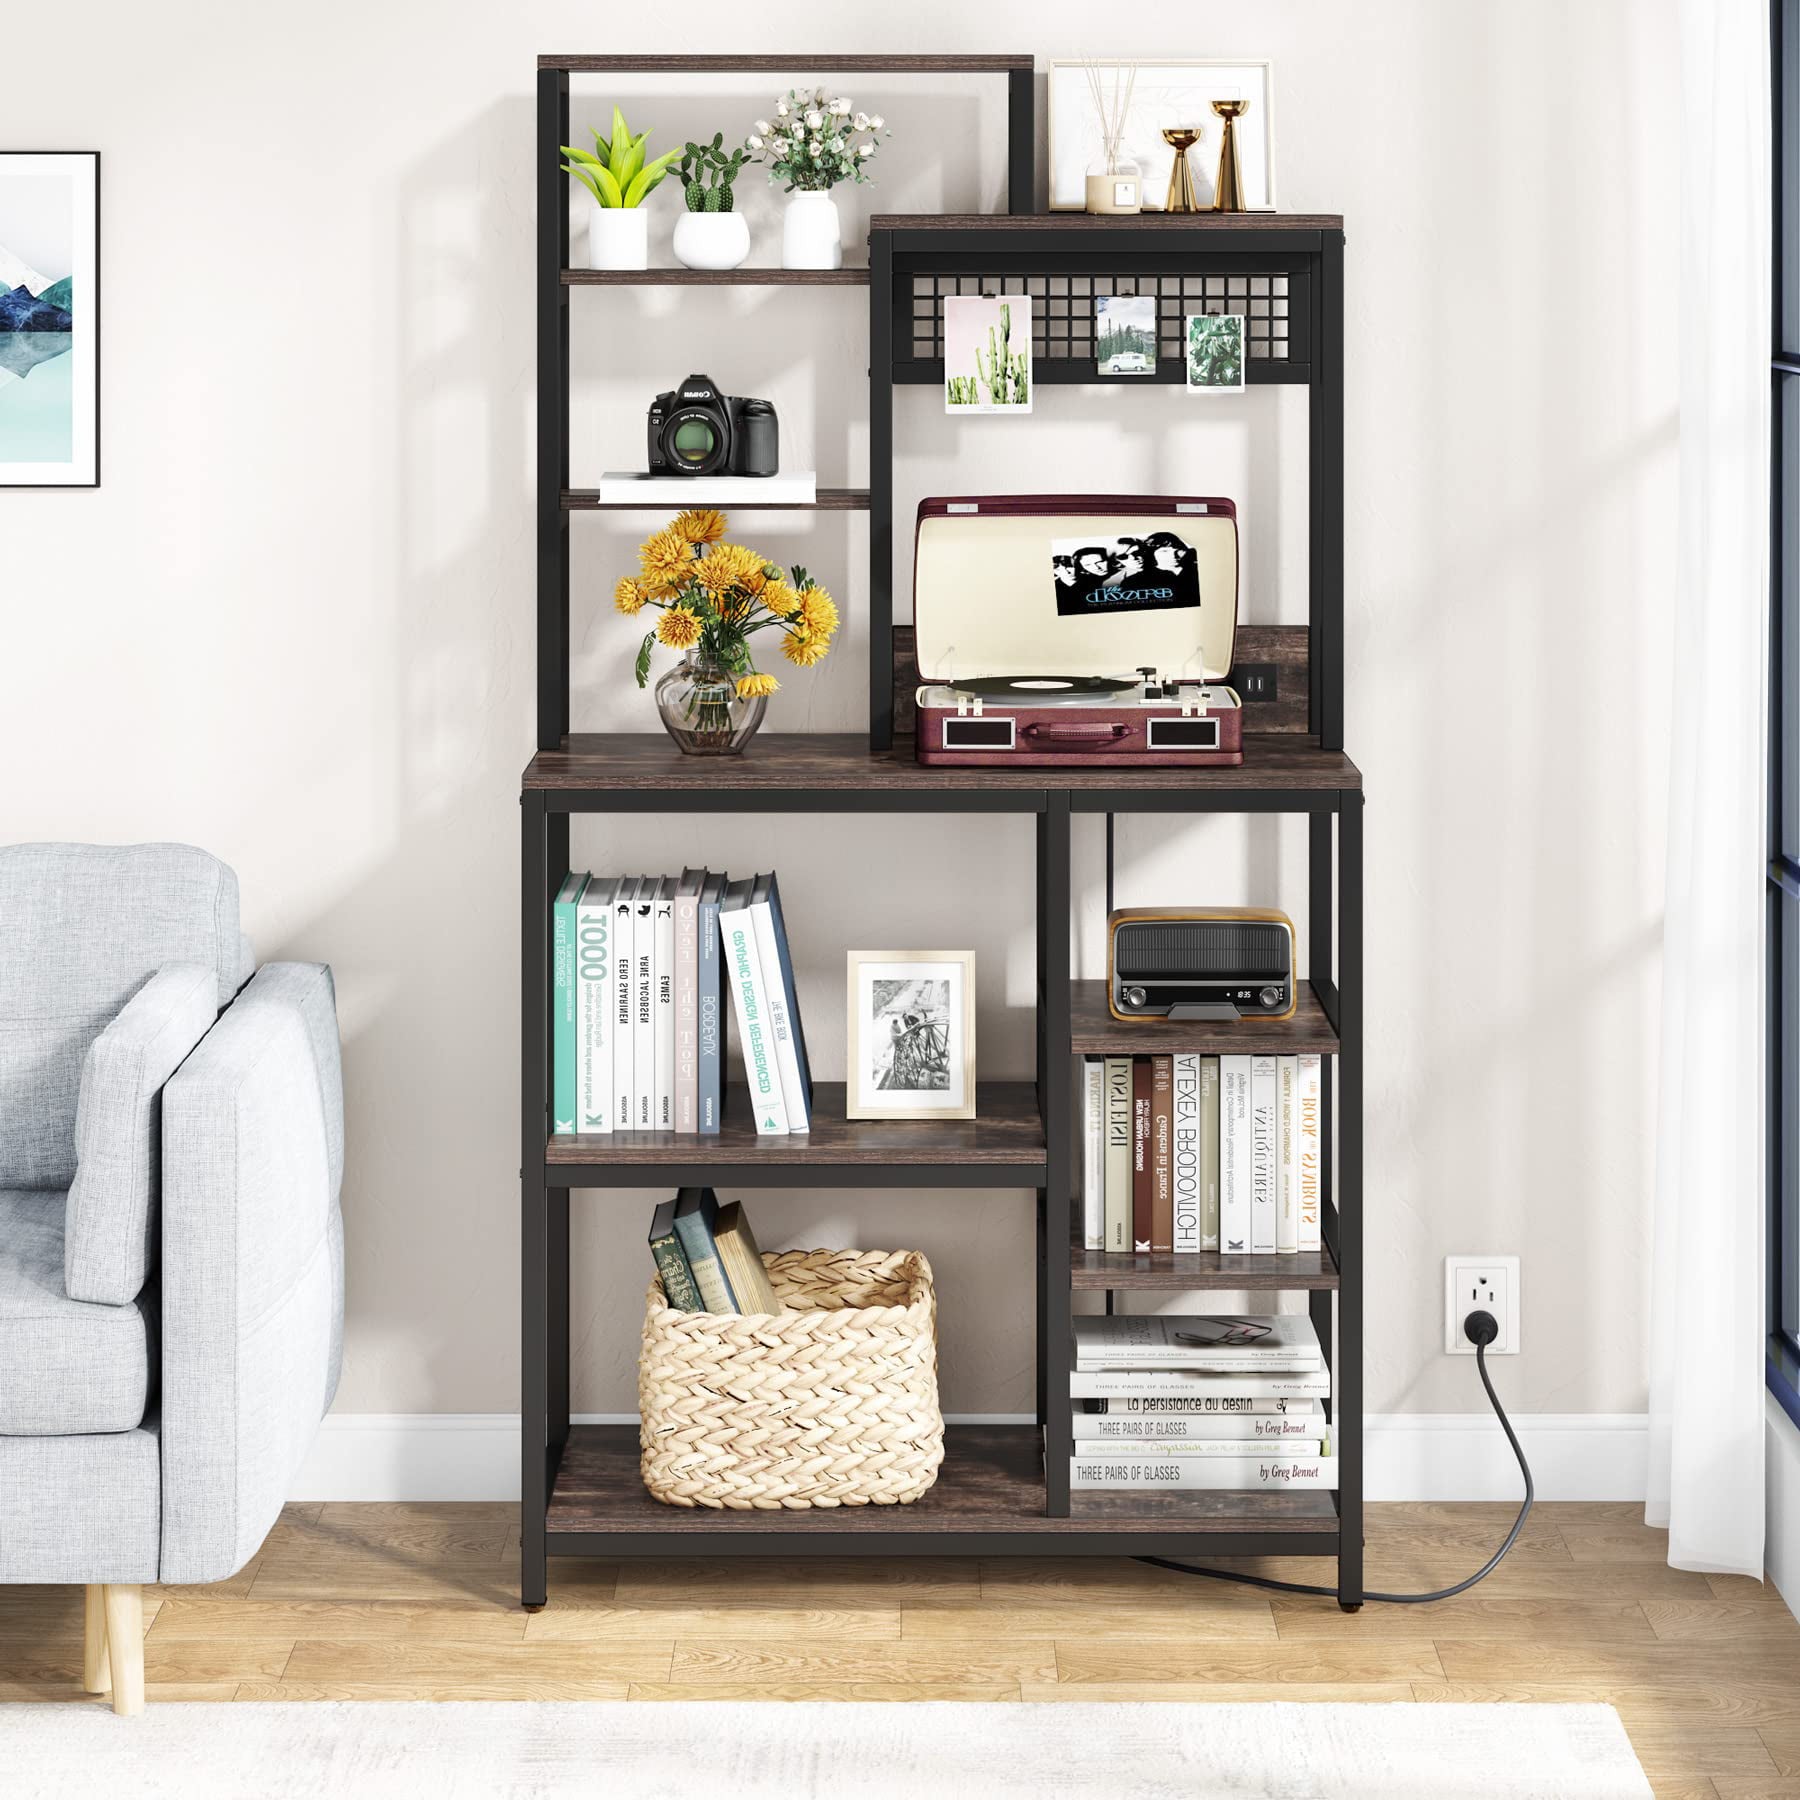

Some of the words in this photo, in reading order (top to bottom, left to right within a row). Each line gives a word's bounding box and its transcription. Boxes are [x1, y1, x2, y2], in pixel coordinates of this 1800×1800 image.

[1127, 1398, 1139, 1410] La
[1142, 1398, 1201, 1414] persistance
[1099, 1422, 1120, 1435] THREE
[1123, 1422, 1142, 1435] PAIRS
[1145, 1422, 1154, 1435] OF
[1156, 1422, 1187, 1435] GLASSES
[1256, 1421, 1264, 1435] by
[1265, 1421, 1280, 1435] Greg
[1283, 1421, 1306, 1433] Bennet
[1077, 1466, 1102, 1480] THREE
[1105, 1466, 1128, 1480] PAIRS
[1131, 1466, 1141, 1480] OF
[1144, 1466, 1180, 1480] GLASSES
[1260, 1465, 1269, 1481] by
[1272, 1465, 1289, 1481] Greg
[1292, 1465, 1318, 1478] Bennet
